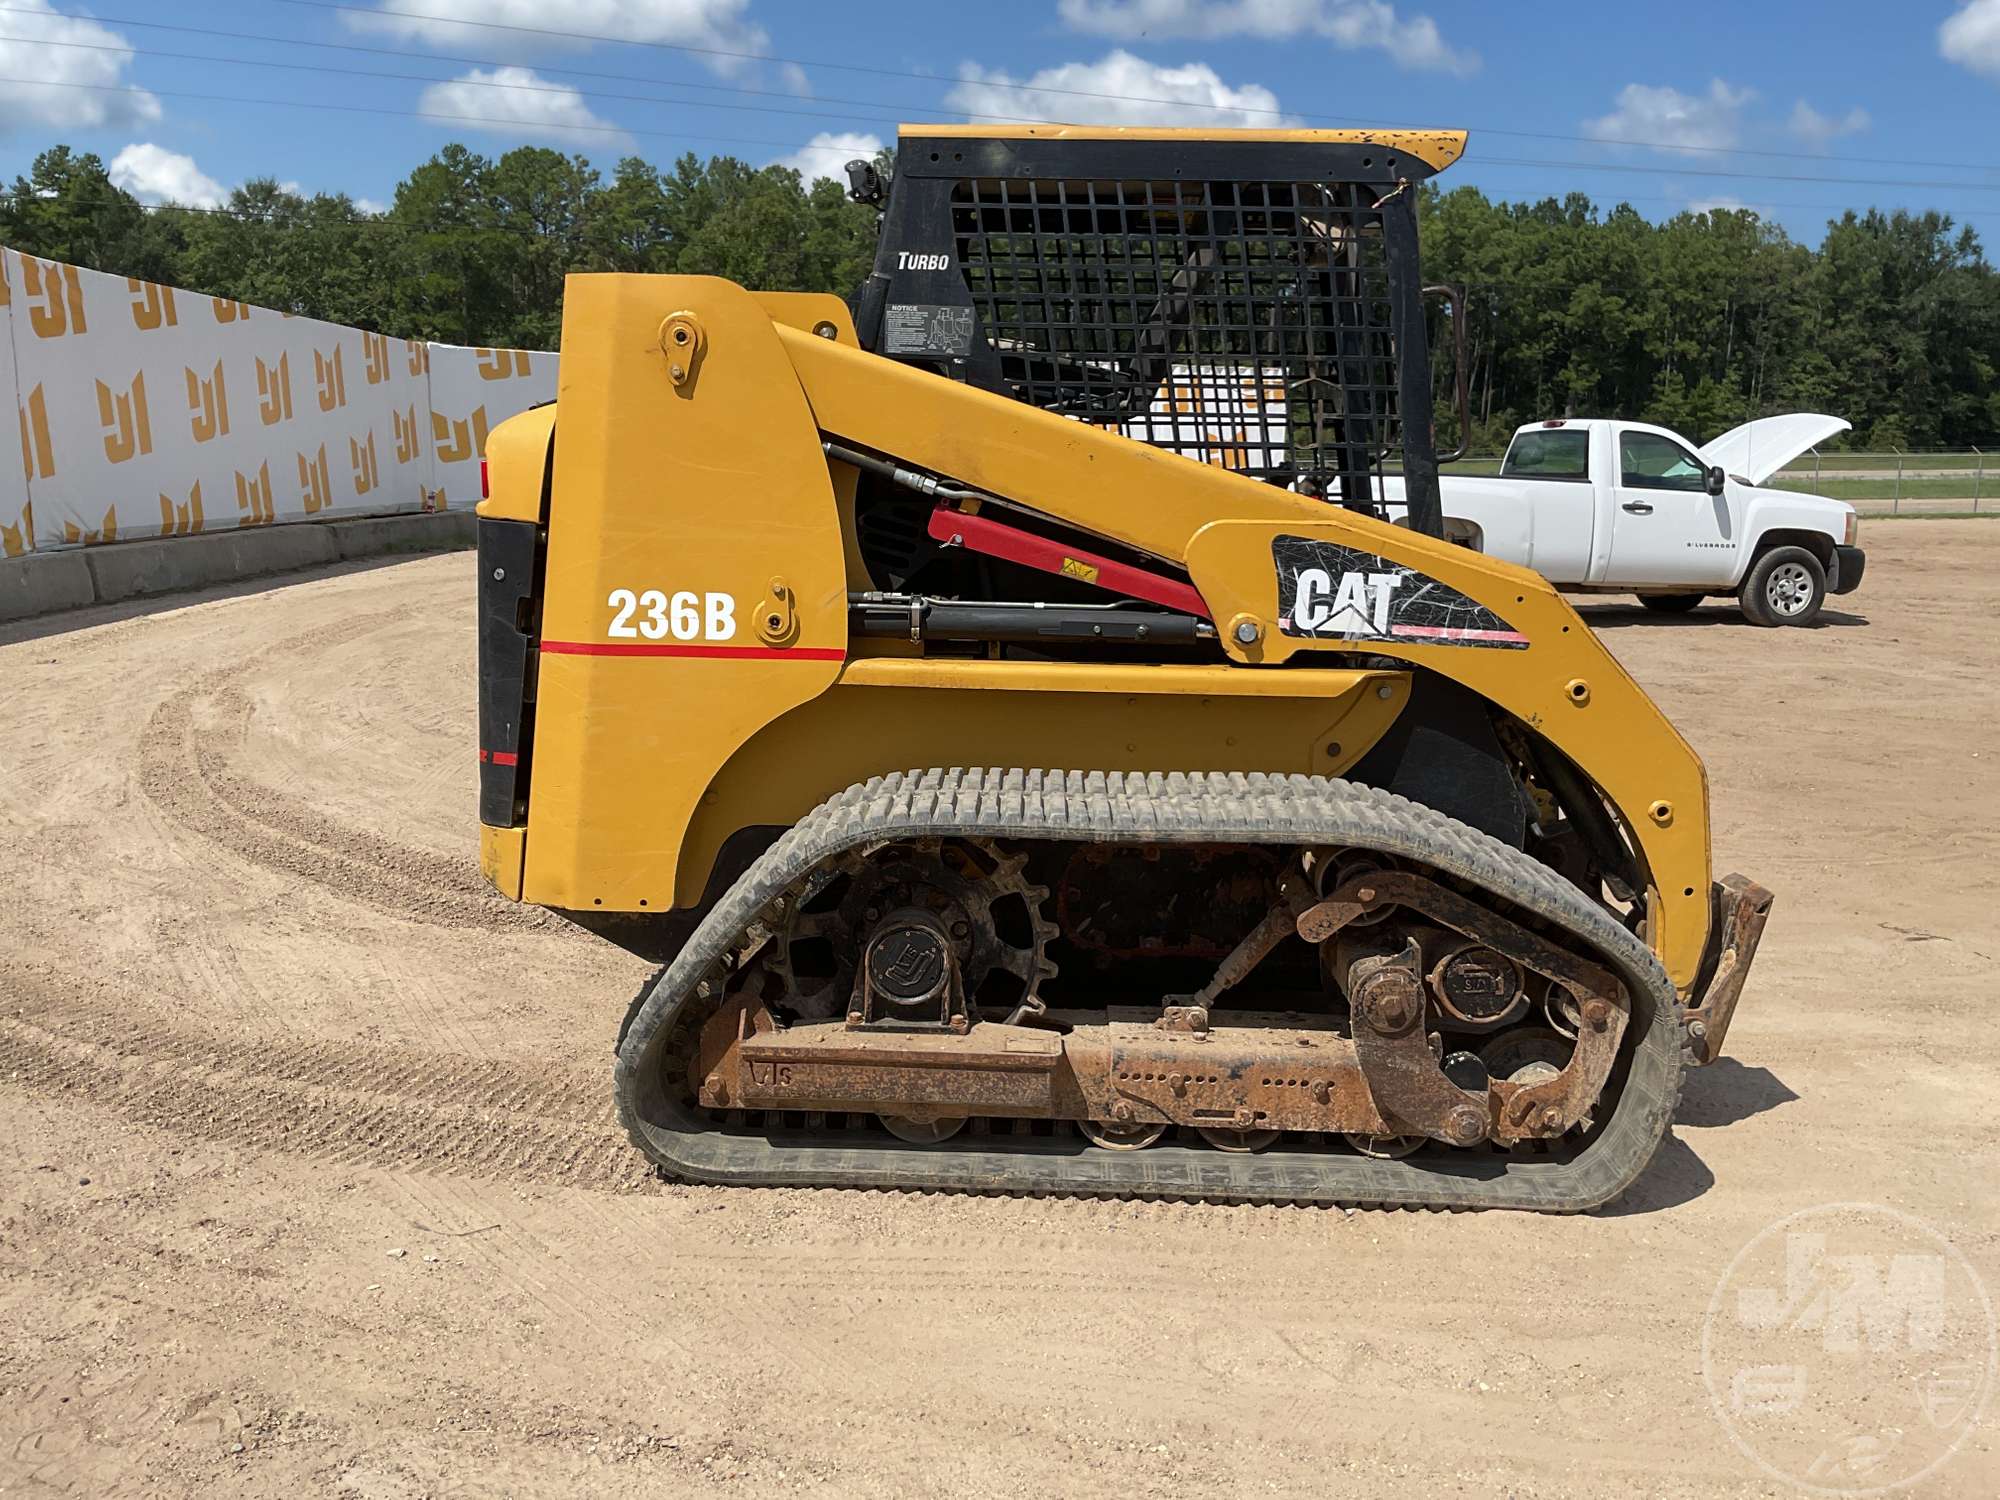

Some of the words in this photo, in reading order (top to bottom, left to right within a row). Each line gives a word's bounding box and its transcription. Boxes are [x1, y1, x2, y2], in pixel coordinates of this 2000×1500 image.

[898, 251, 949, 270] TURBO
[607, 588, 737, 641] 236B
[1294, 568, 1401, 635] CAT
